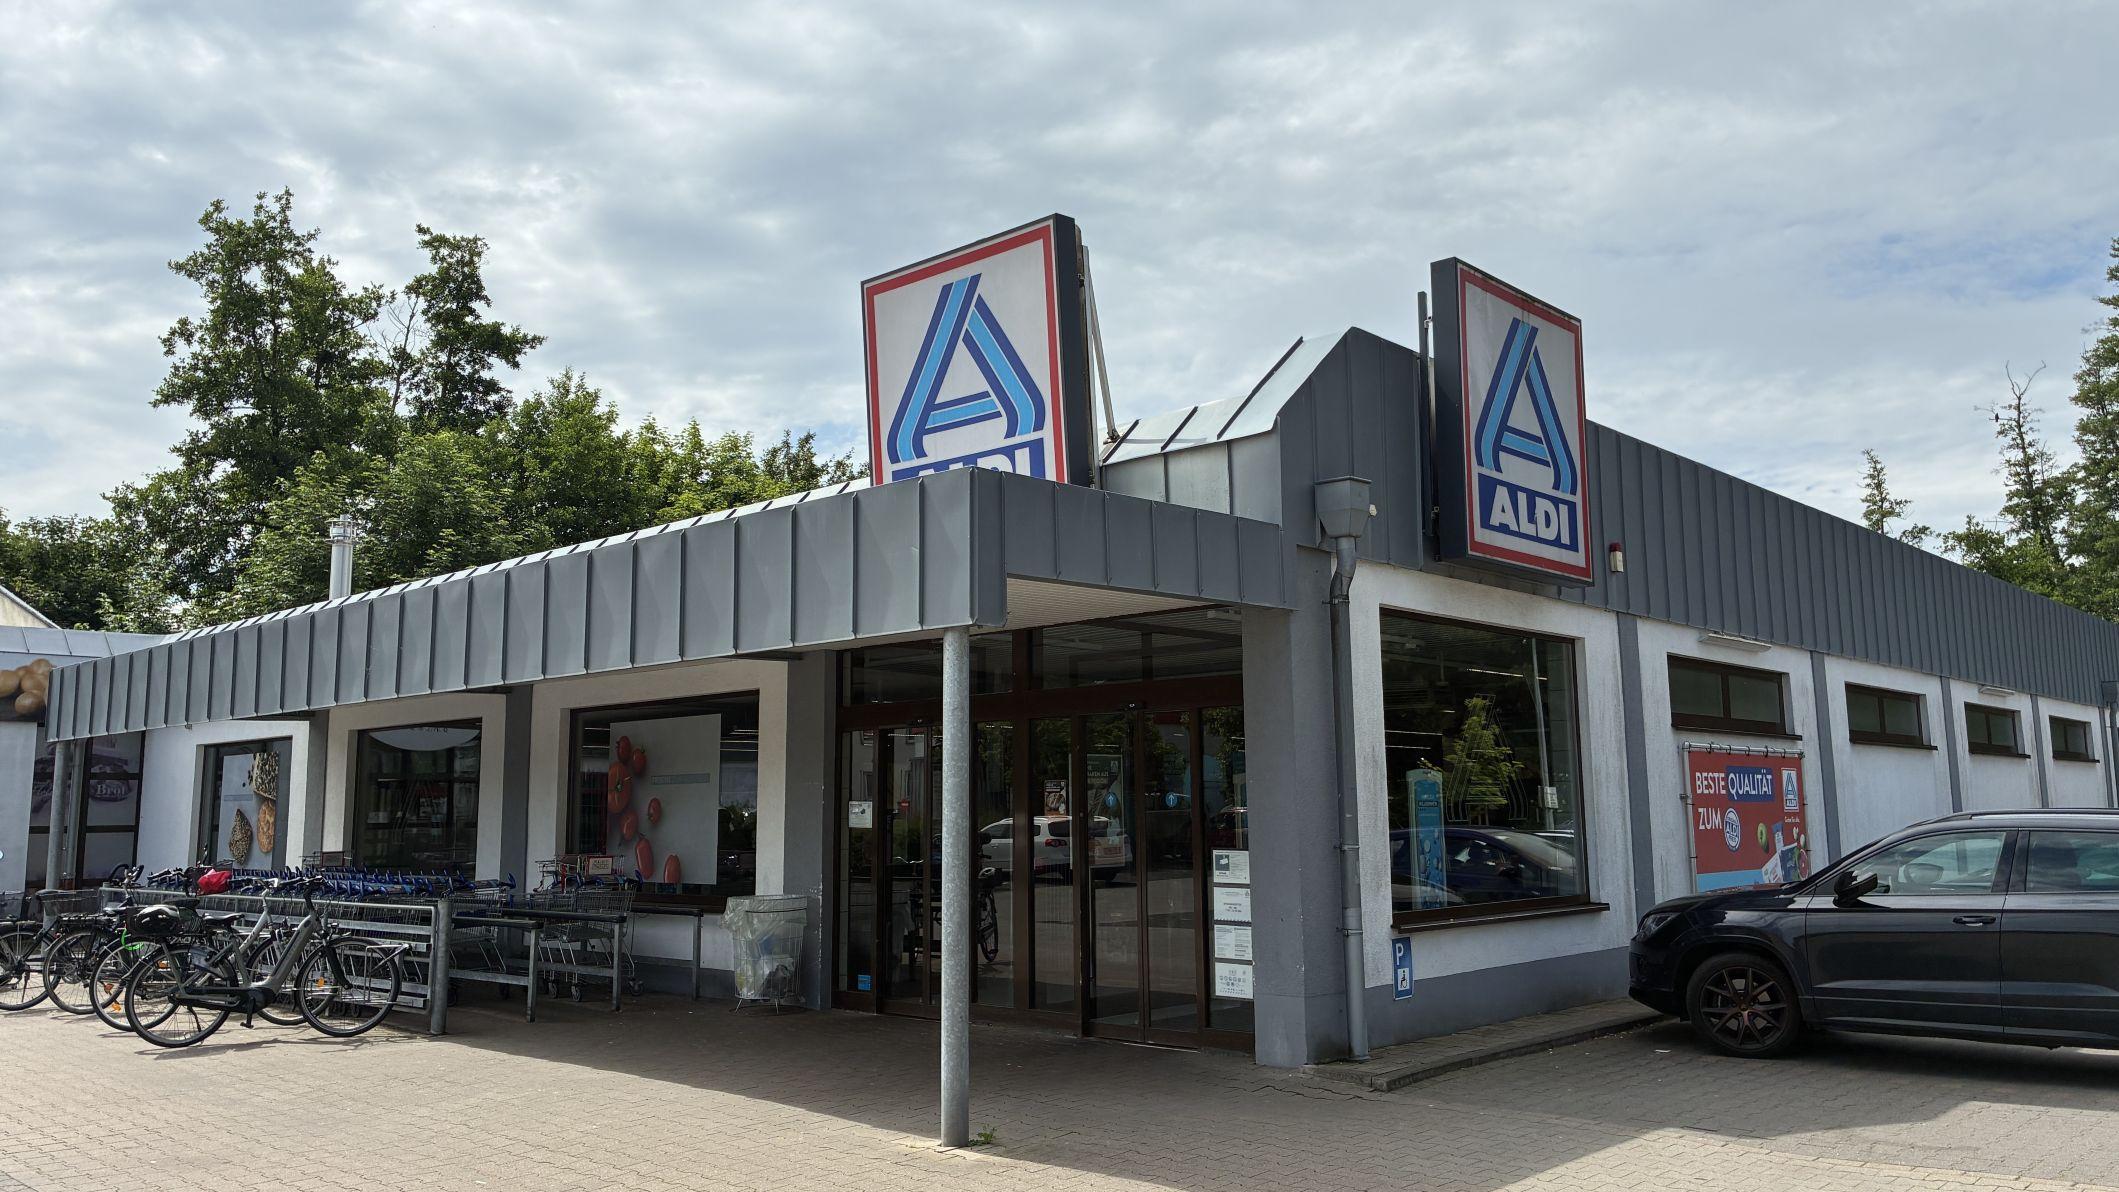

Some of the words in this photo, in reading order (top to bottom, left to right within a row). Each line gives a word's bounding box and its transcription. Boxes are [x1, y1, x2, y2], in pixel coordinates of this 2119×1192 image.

[1489, 484, 1570, 545] ALDI
[1696, 772, 1726, 794] BESTE
[1728, 769, 1772, 800] QUALITÄT
[1698, 808, 1722, 829] ZUM
[1395, 942, 1404, 966] P
